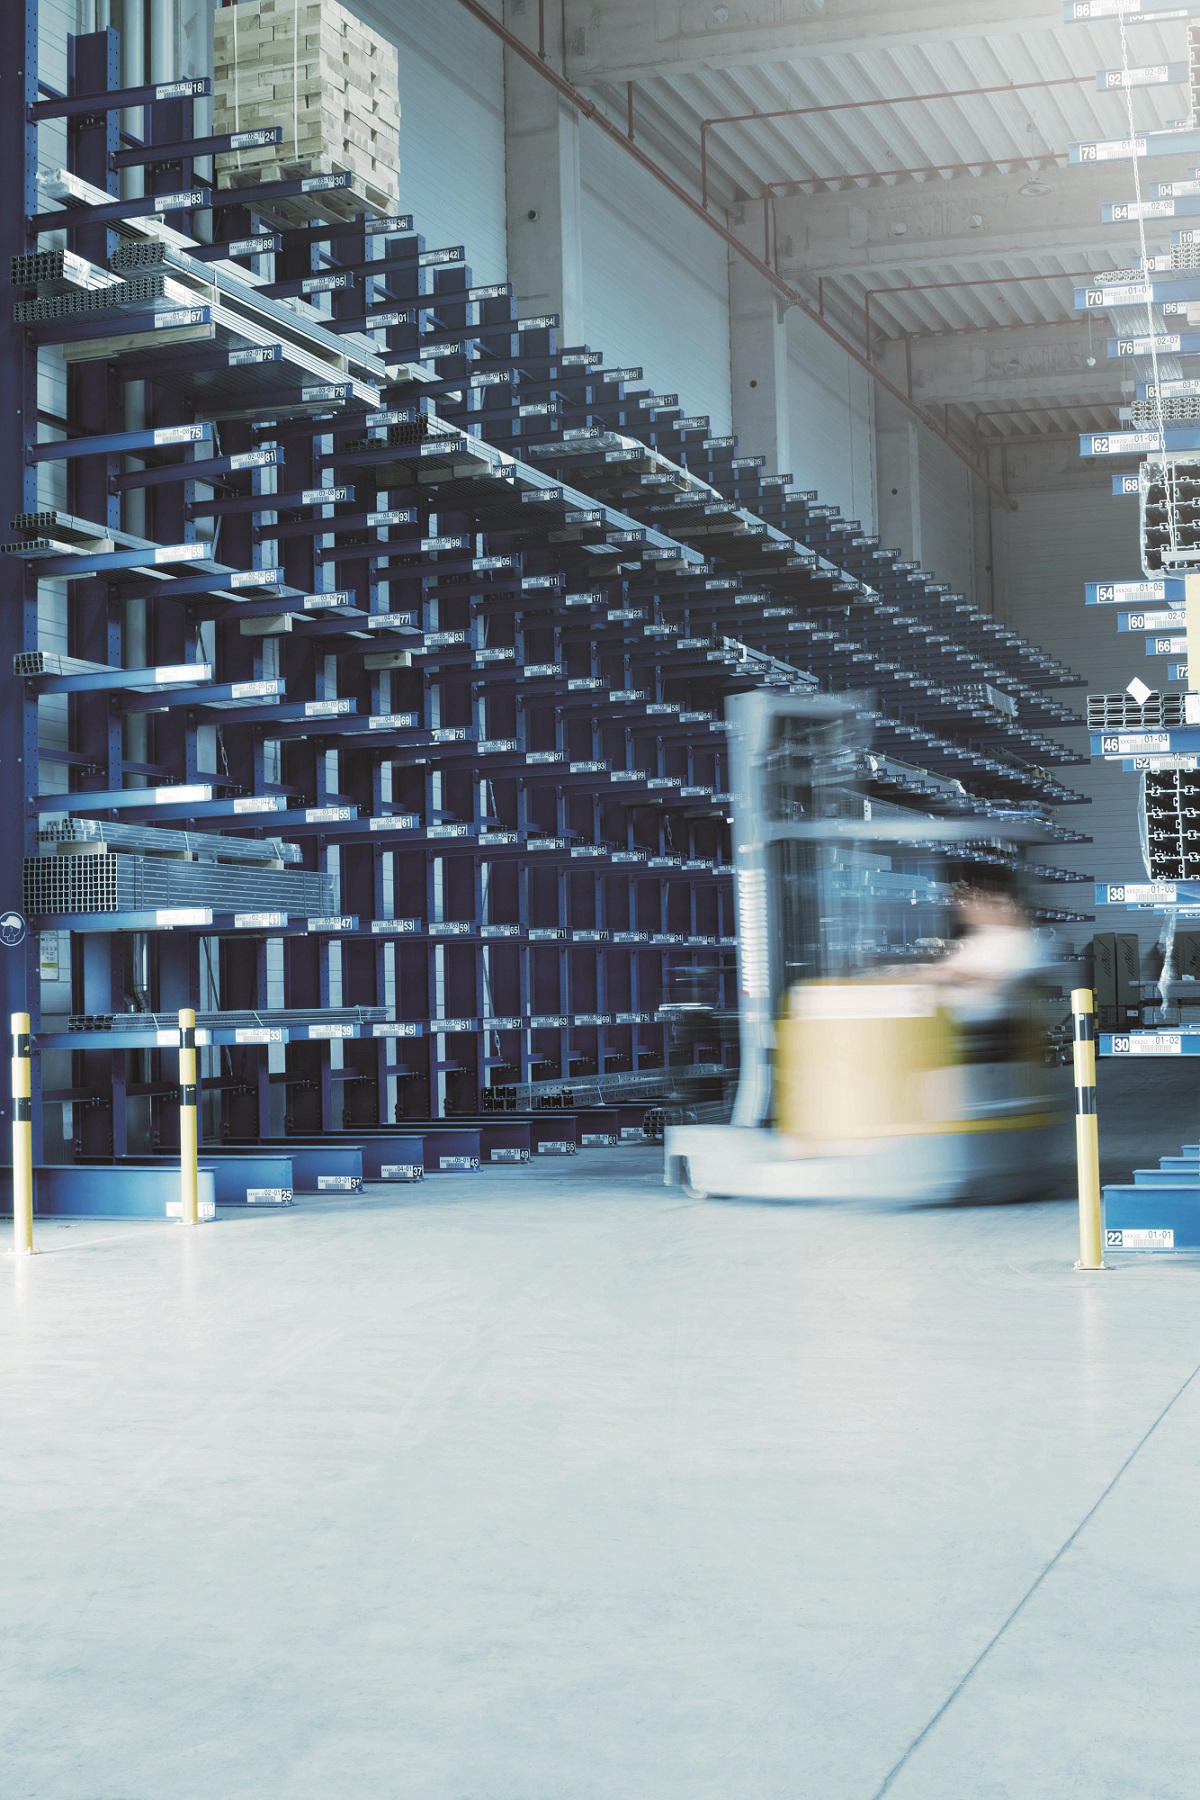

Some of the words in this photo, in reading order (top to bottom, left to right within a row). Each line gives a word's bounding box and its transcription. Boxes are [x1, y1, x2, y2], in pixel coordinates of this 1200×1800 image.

[1076, 5, 1090, 17] 86
[1108, 74, 1121, 85] 92
[1144, 67, 1167, 76] 02-09
[192, 82, 202, 93] 18
[264, 132, 274, 140] 24
[1081, 147, 1096, 159] 78
[334, 177, 344, 185] 30
[1160, 186, 1172, 196] 04
[191, 193, 201, 204] 83
[1114, 206, 1127, 218] 84
[396, 219, 406, 228] 36
[1181, 232, 1193, 242] 10
[263, 239, 272, 249] 89
[449, 250, 457, 259] 42
[335, 277, 344, 286] 95
[1088, 290, 1102, 304] 70
[1165, 303, 1177, 313] 96
[191, 311, 200, 321] 67
[398, 314, 407, 322] 01
[450, 345, 458, 353] 07
[1120, 343, 1133, 354] 76
[1156, 336, 1179, 345] 02-07
[263, 350, 272, 360] 73
[499, 373, 507, 381] 13
[1182, 380, 1200, 389] 03-0
[334, 387, 344, 396] 79
[547, 404, 554, 412] 19
[190, 428, 200, 438] 75
[450, 442, 459, 450] 91
[1094, 439, 1108, 451] 62
[1134, 434, 1158, 442] 01-06
[265, 453, 274, 462] 81
[501, 468, 509, 476] 97
[1125, 479, 1138, 491] 68
[335, 490, 344, 499] 87
[399, 513, 408, 521] 93
[451, 539, 459, 547] 99
[191, 546, 201, 557] 59
[265, 572, 275, 582] 65
[550, 577, 557, 585] 11
[1099, 588, 1113, 600] 54
[1139, 582, 1163, 591] 01-05
[336, 594, 345, 604] 71
[400, 615, 409, 624] 77
[1130, 616, 1144, 628] 60
[454, 633, 462, 642] 83
[1157, 641, 1170, 652] 66
[266, 682, 276, 692] 57
[338, 702, 348, 711] 63
[400, 717, 409, 725] 69
[455, 730, 463, 738] 75
[1104, 739, 1118, 751] 46
[1144, 735, 1168, 743] 01-04
[1135, 758, 1150, 769] 52
[339, 811, 348, 819] 55
[401, 819, 410, 827] 61
[508, 833, 516, 842] 73
[1109, 888, 1124, 900] 38
[341, 919, 350, 928] 47
[403, 921, 412, 930] 53
[459, 924, 468, 932] 59
[557, 929, 564, 938] 71
[404, 1025, 413, 1034] 45
[460, 1021, 469, 1029] 51
[269, 1030, 279, 1040] 33
[341, 1026, 351, 1036] 39
[1114, 1038, 1129, 1051] 30
[520, 1151, 528, 1159] 49
[470, 1159, 478, 1168] 43
[413, 1167, 422, 1176] 37
[351, 1179, 360, 1188] 31
[281, 1191, 292, 1201] 25
[202, 1204, 213, 1215] 19
[1107, 1232, 1122, 1245] 22
[1147, 1230, 1171, 1239] 01-01
